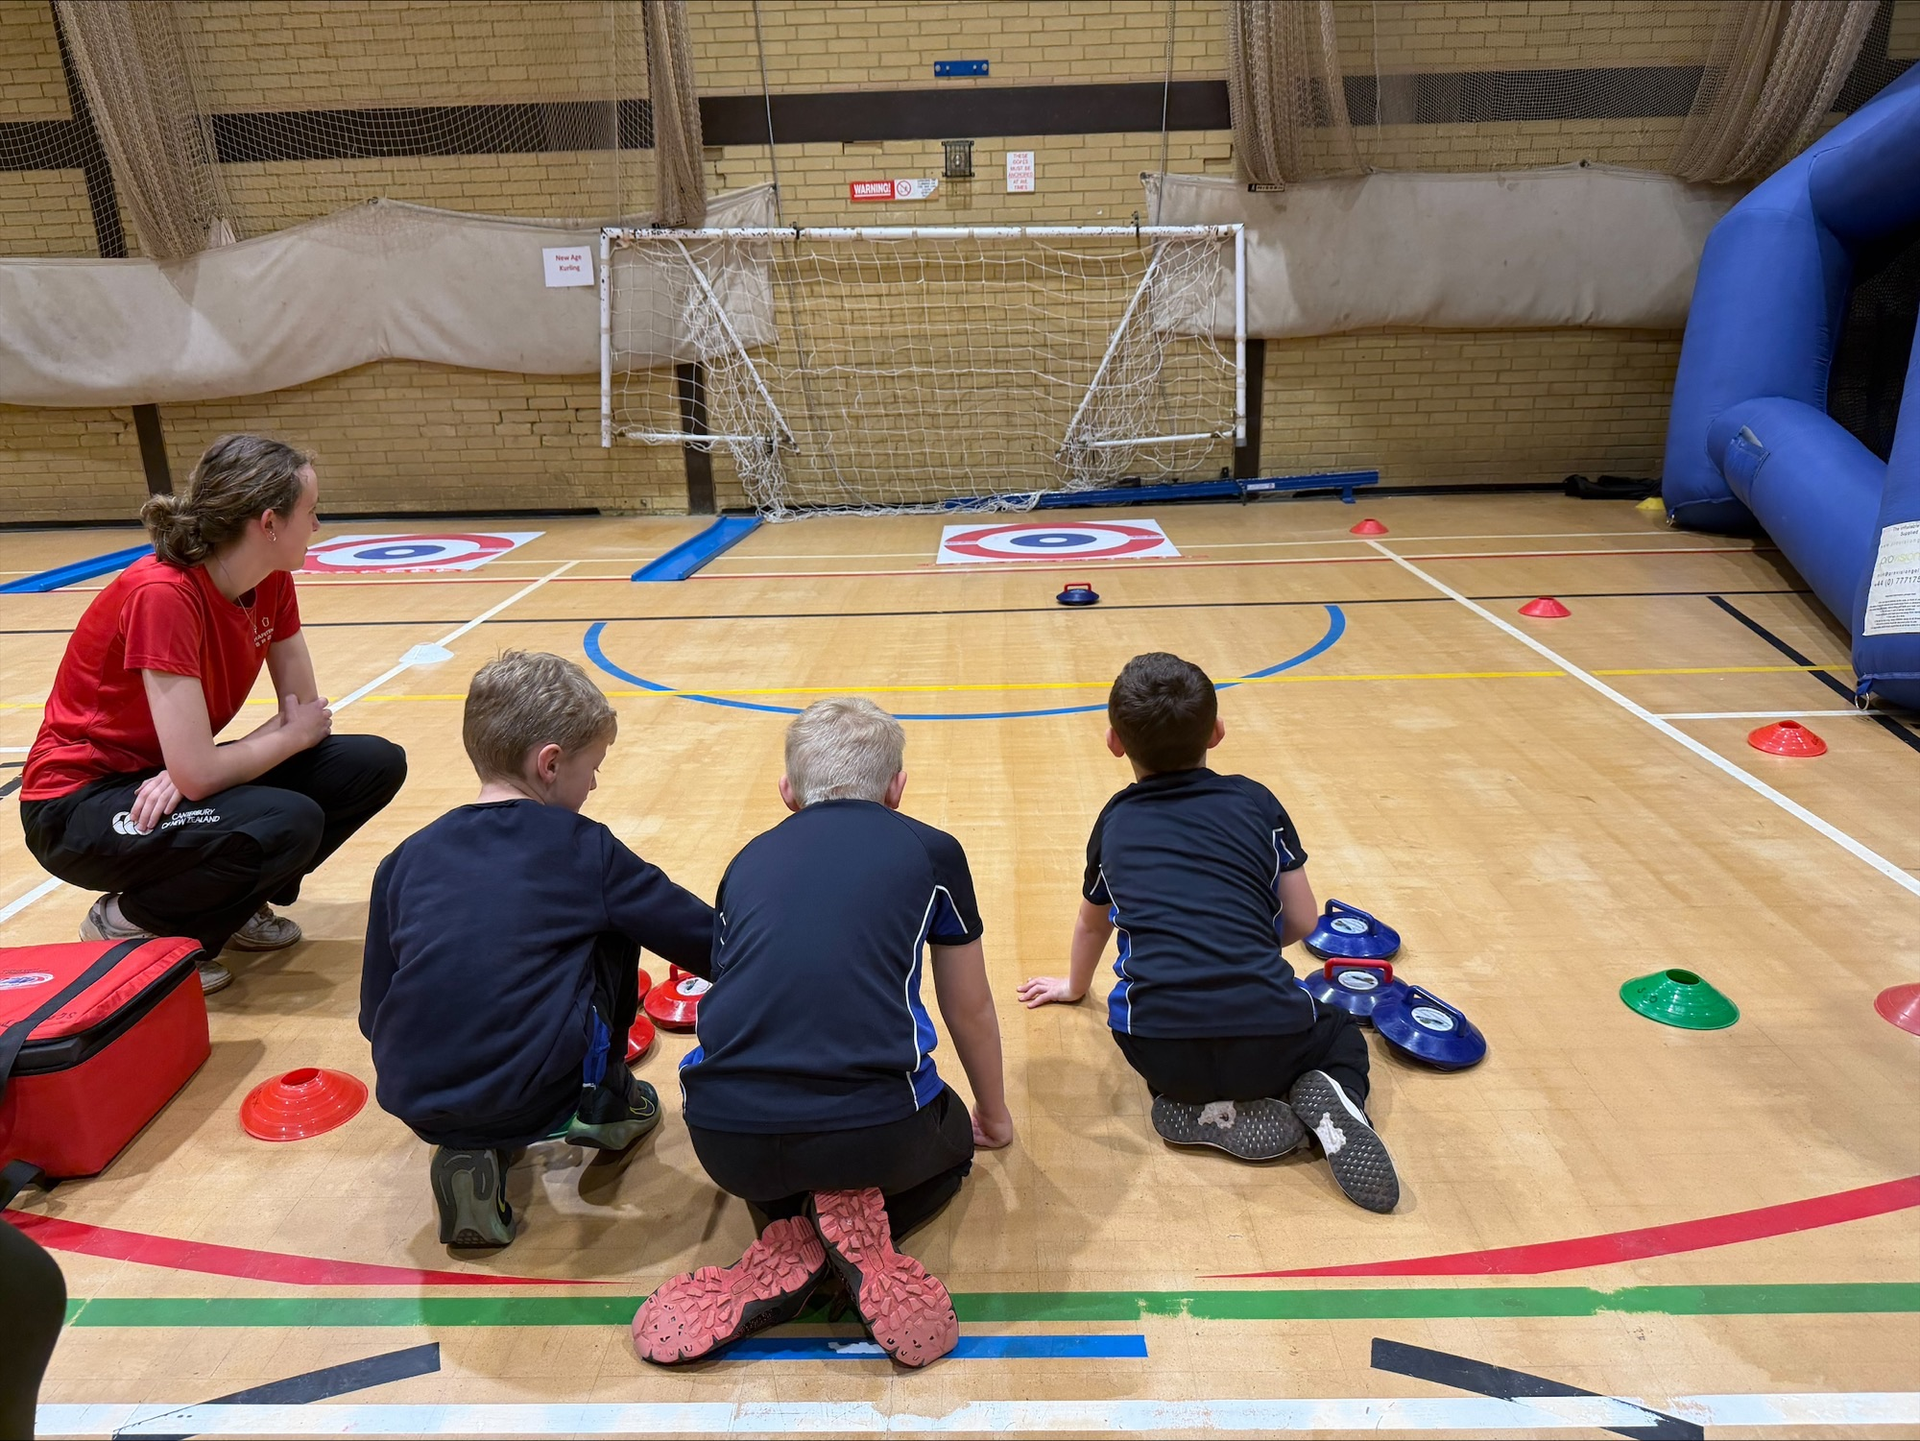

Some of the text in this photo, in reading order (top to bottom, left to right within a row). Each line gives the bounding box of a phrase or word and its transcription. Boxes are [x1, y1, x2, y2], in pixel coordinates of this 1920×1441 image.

[853, 183, 891, 195] WARNING!
[570, 254, 582, 262] Age
[559, 264, 581, 272] Kurling
[171, 808, 216, 821] CANTERBURY
[187, 815, 220, 824] ZEALAND
